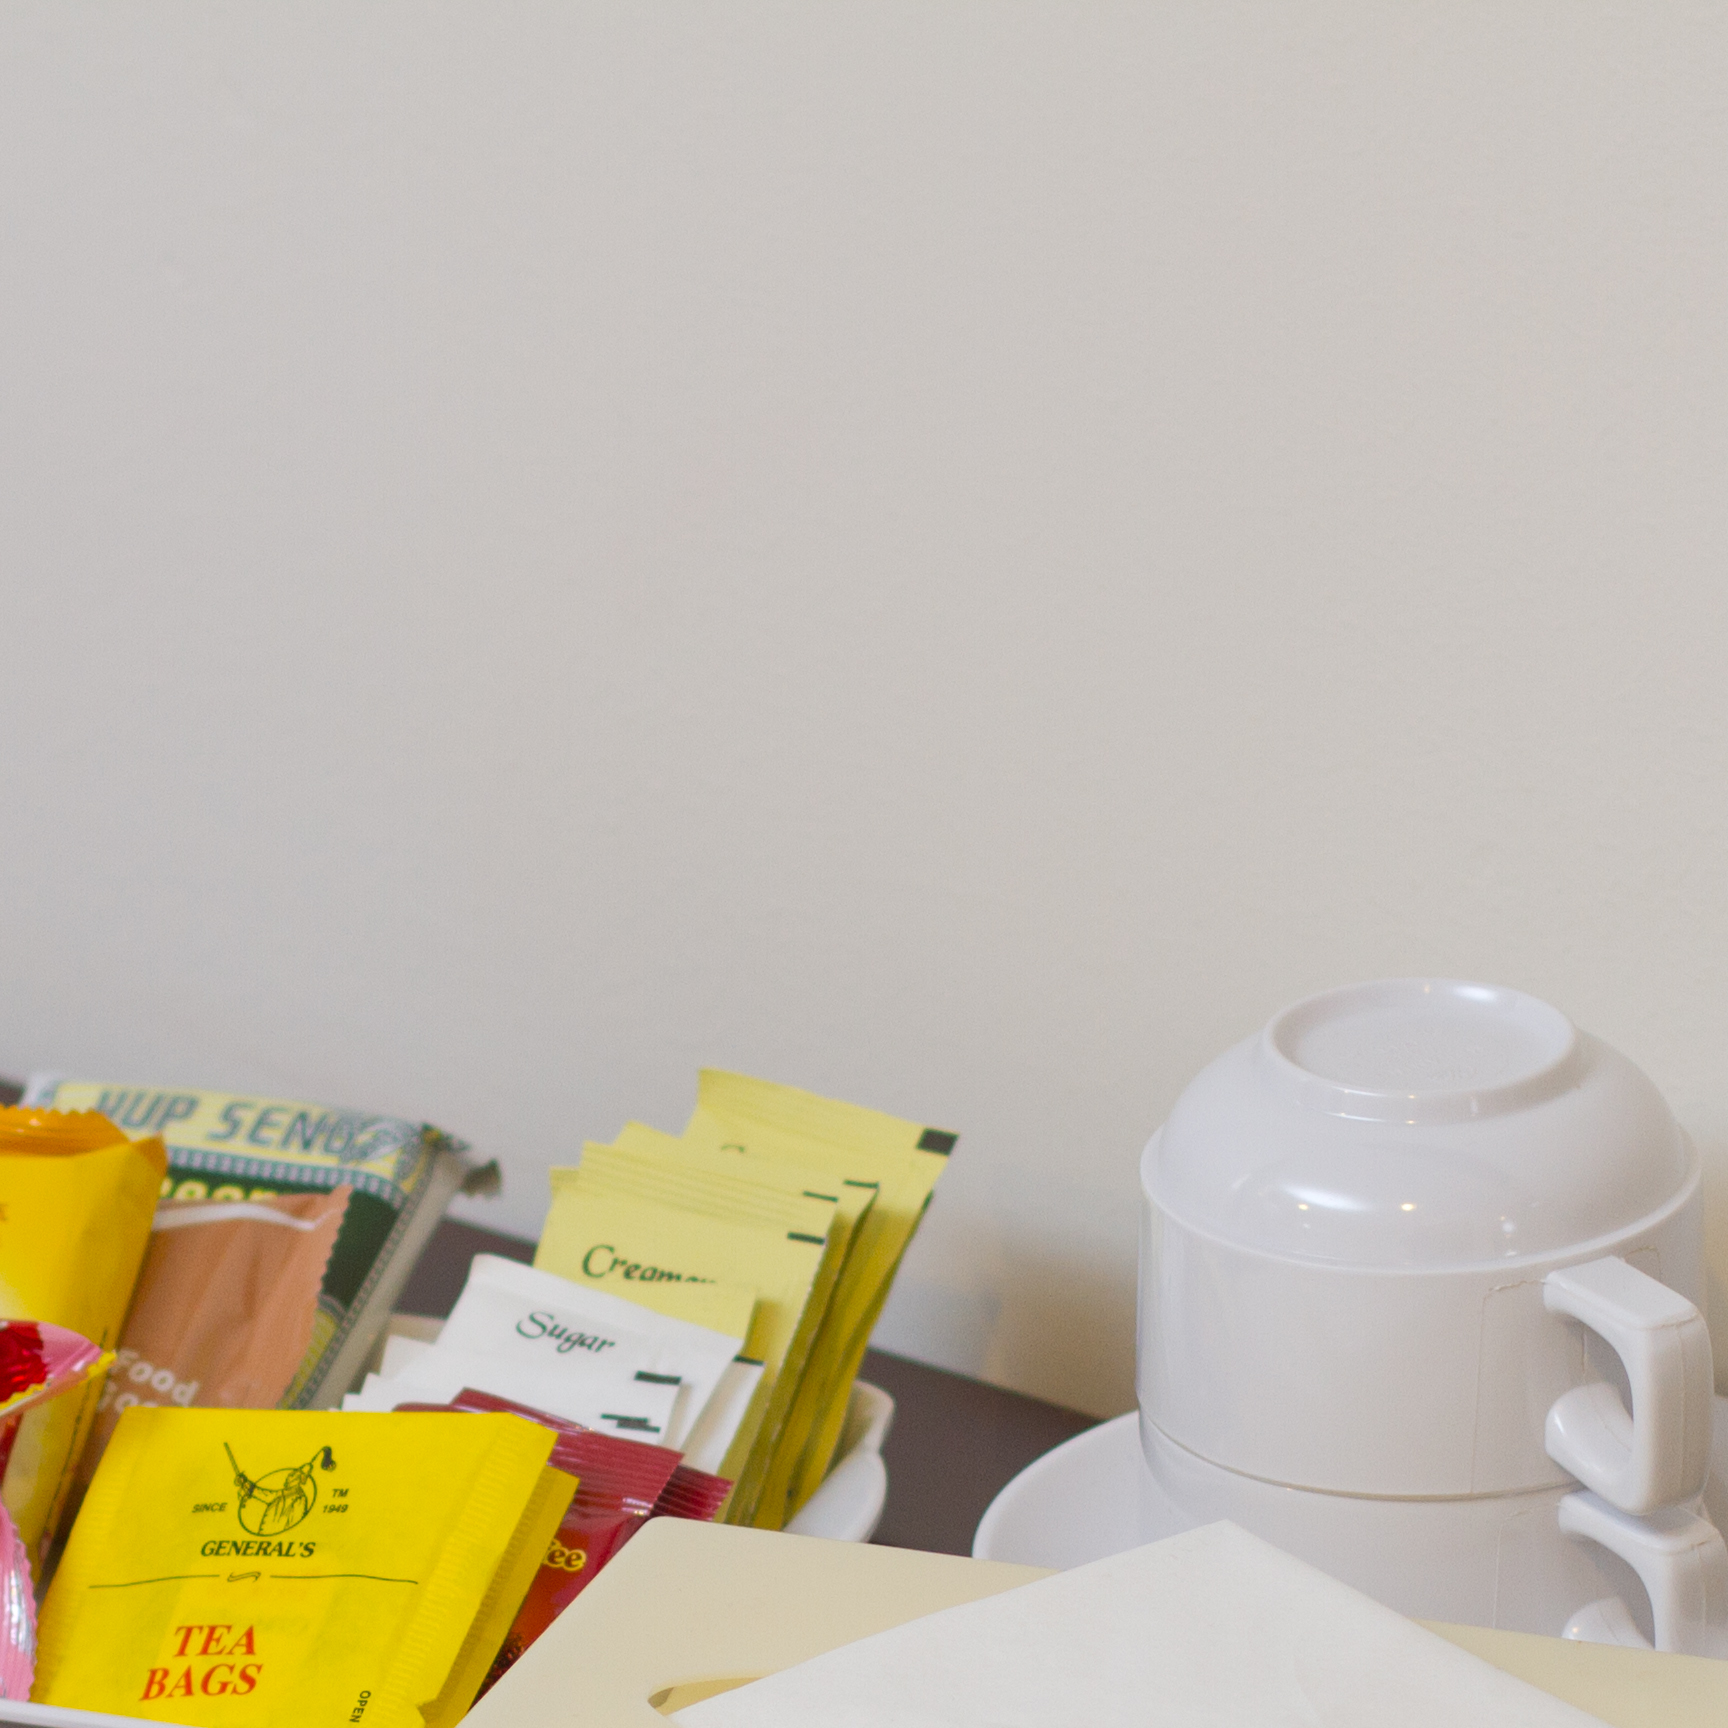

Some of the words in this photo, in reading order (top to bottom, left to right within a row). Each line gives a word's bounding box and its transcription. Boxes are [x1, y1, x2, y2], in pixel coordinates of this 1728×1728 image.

[96, 1089, 198, 1131] HUP
[581, 1244, 716, 1283] Cream
[516, 1311, 615, 1353] Sugar
[191, 1502, 228, 1514] SINCE
[322, 1504, 349, 1515] 1949
[332, 1488, 349, 1498] TM
[200, 1540, 316, 1558] GENERAL'S
[173, 1624, 258, 1658] TEA
[139, 1663, 264, 1701] BAGS
[349, 1690, 371, 1723] OPEN
